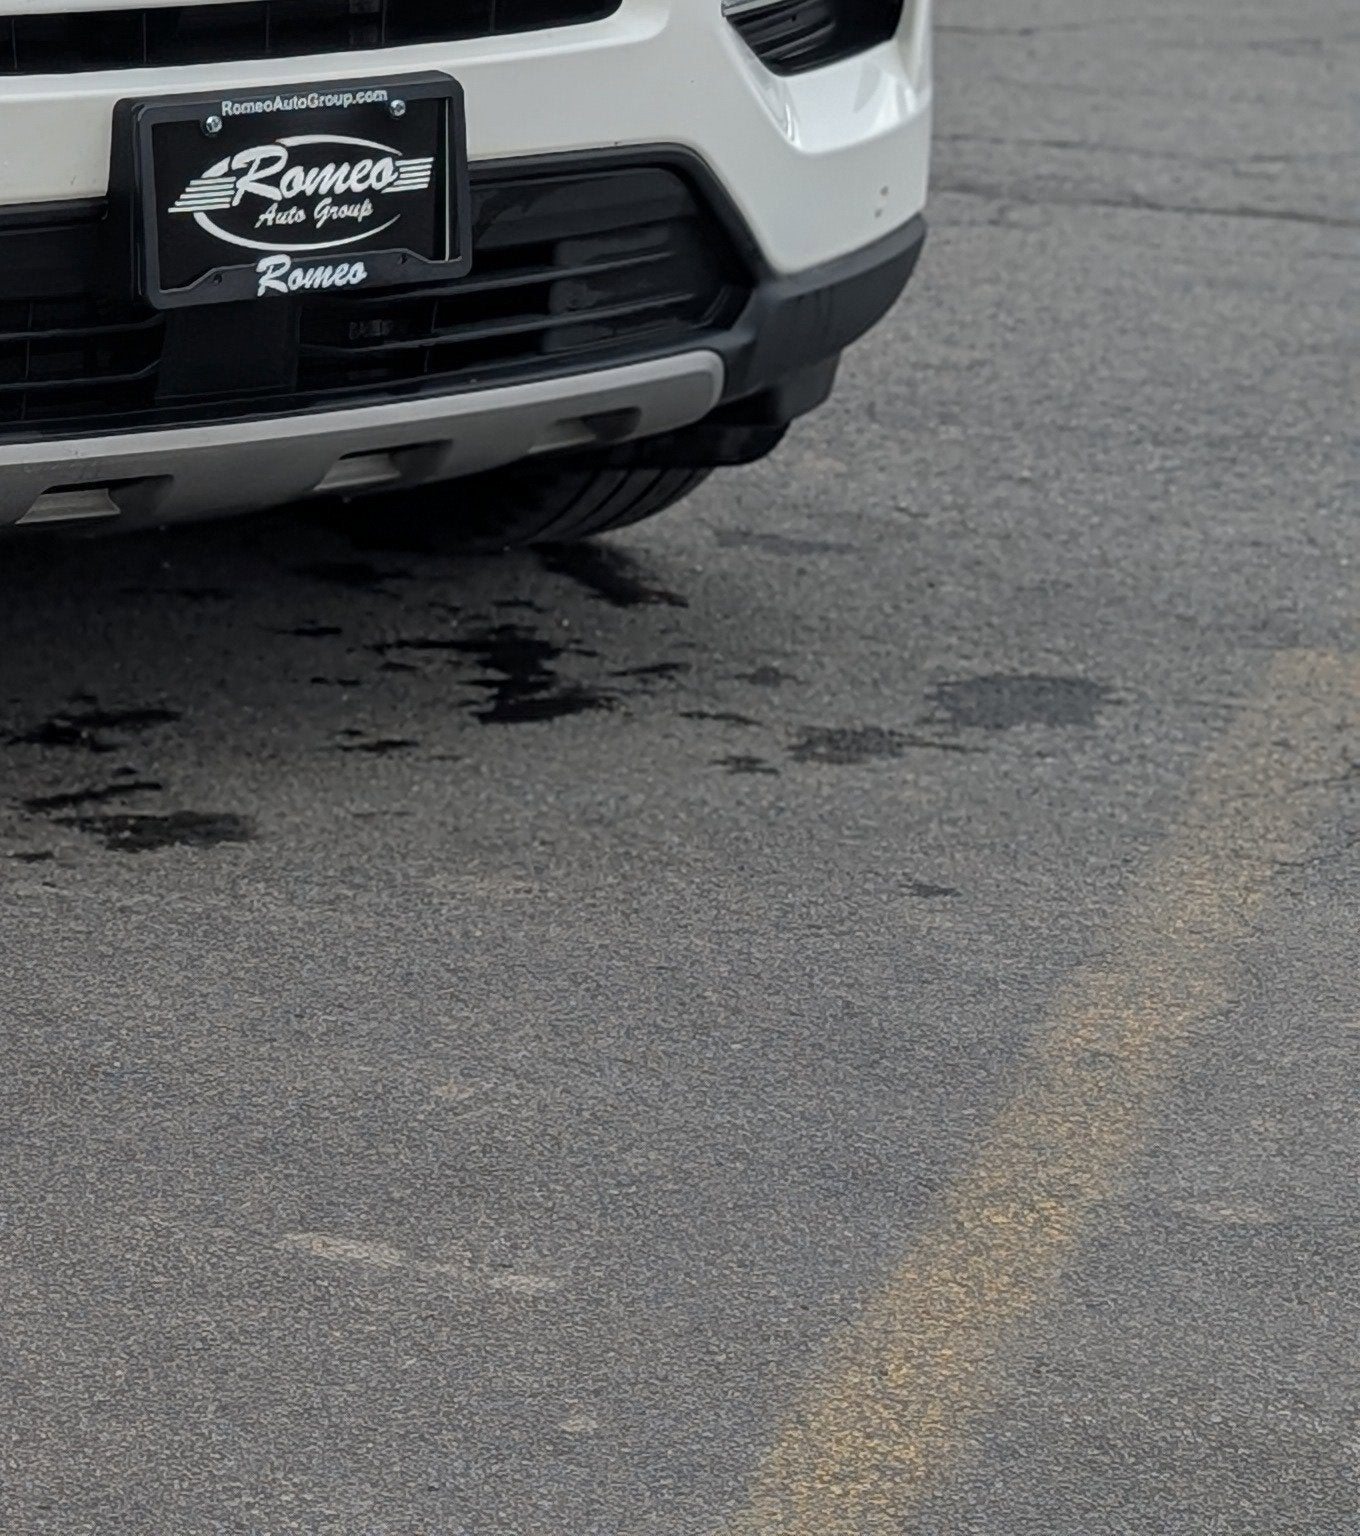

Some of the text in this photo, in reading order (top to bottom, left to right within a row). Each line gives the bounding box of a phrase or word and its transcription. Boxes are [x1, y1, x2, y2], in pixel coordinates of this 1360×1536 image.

[221, 89, 388, 116] RomeoAutoGroup.com
[231, 144, 400, 207] Romeo
[254, 197, 374, 229] Auto Group
[256, 253, 368, 298] Romeo
